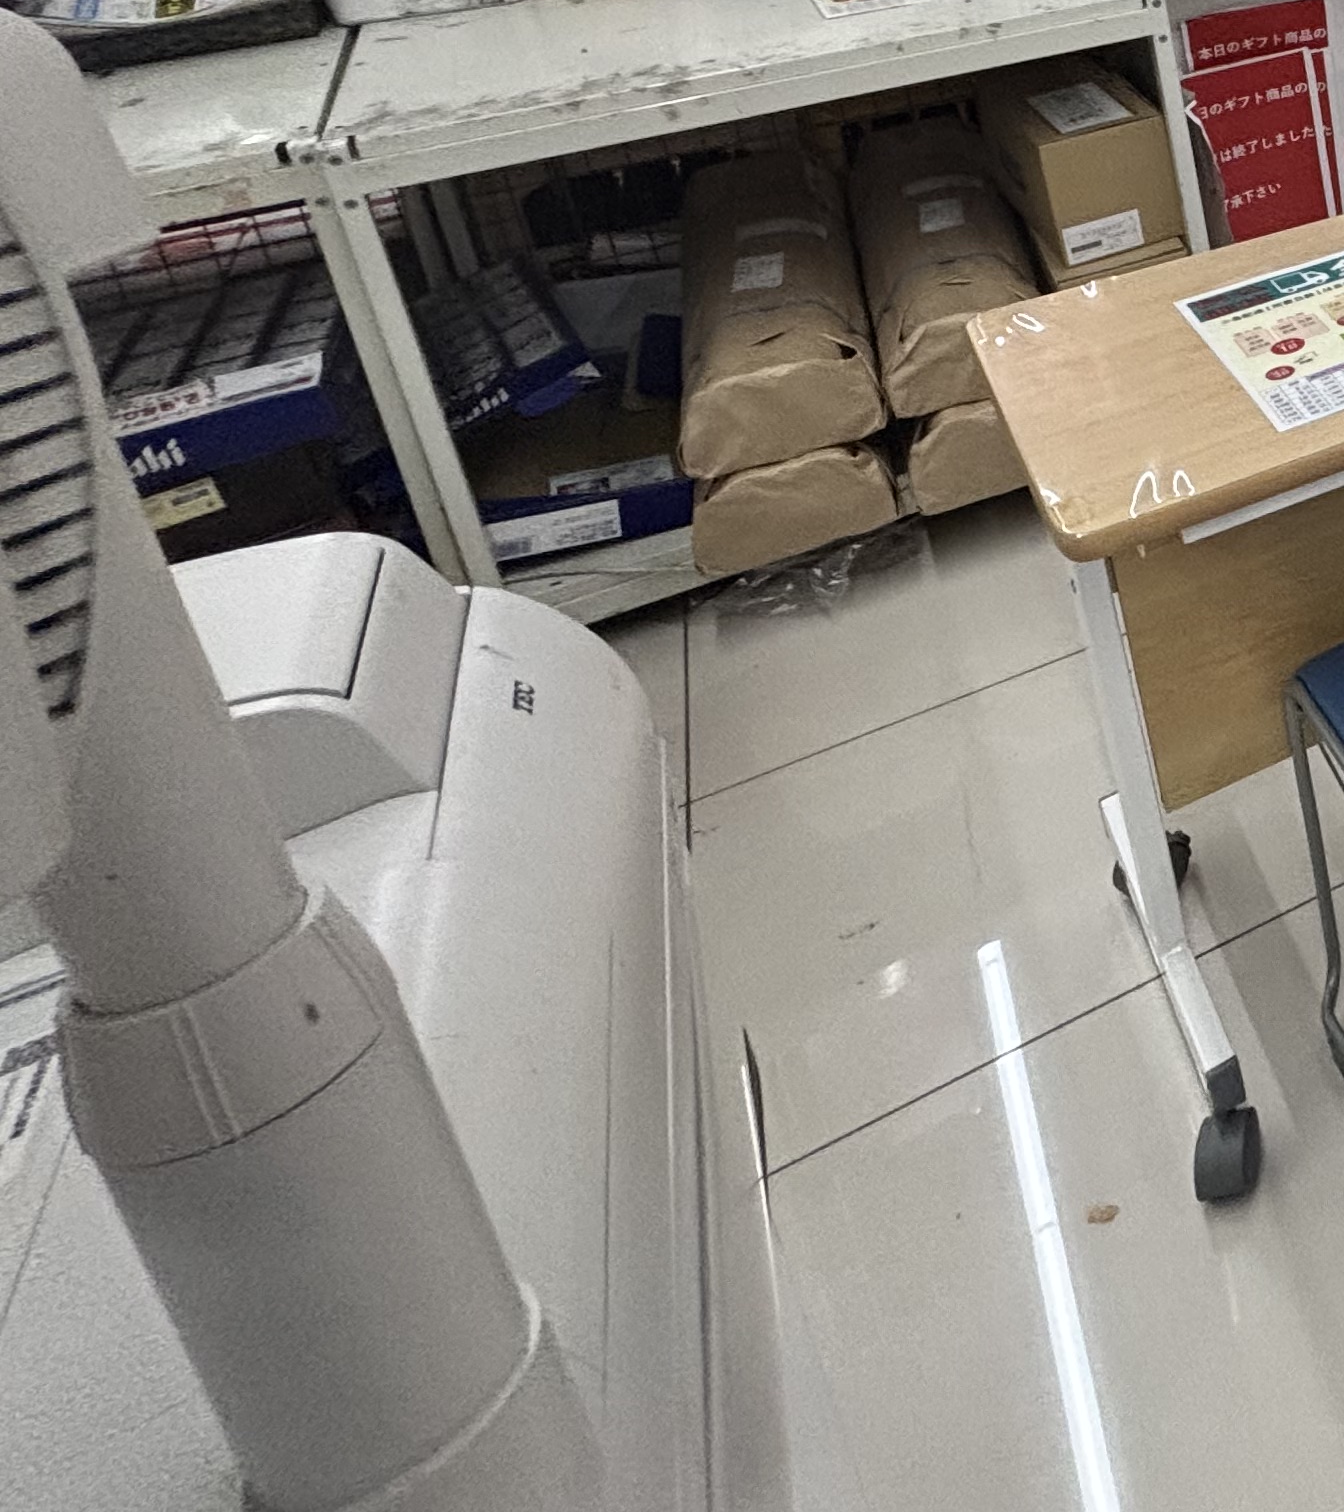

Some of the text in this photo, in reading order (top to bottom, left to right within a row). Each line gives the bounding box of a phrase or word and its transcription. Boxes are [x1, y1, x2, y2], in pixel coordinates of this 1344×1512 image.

[1198, 26, 1328, 62] 本日のギフト商品の
[1198, 81, 1309, 121] 日のギフト商品の
[1213, 125, 1316, 165] は終了しました
[512, 680, 537, 715] TEC
